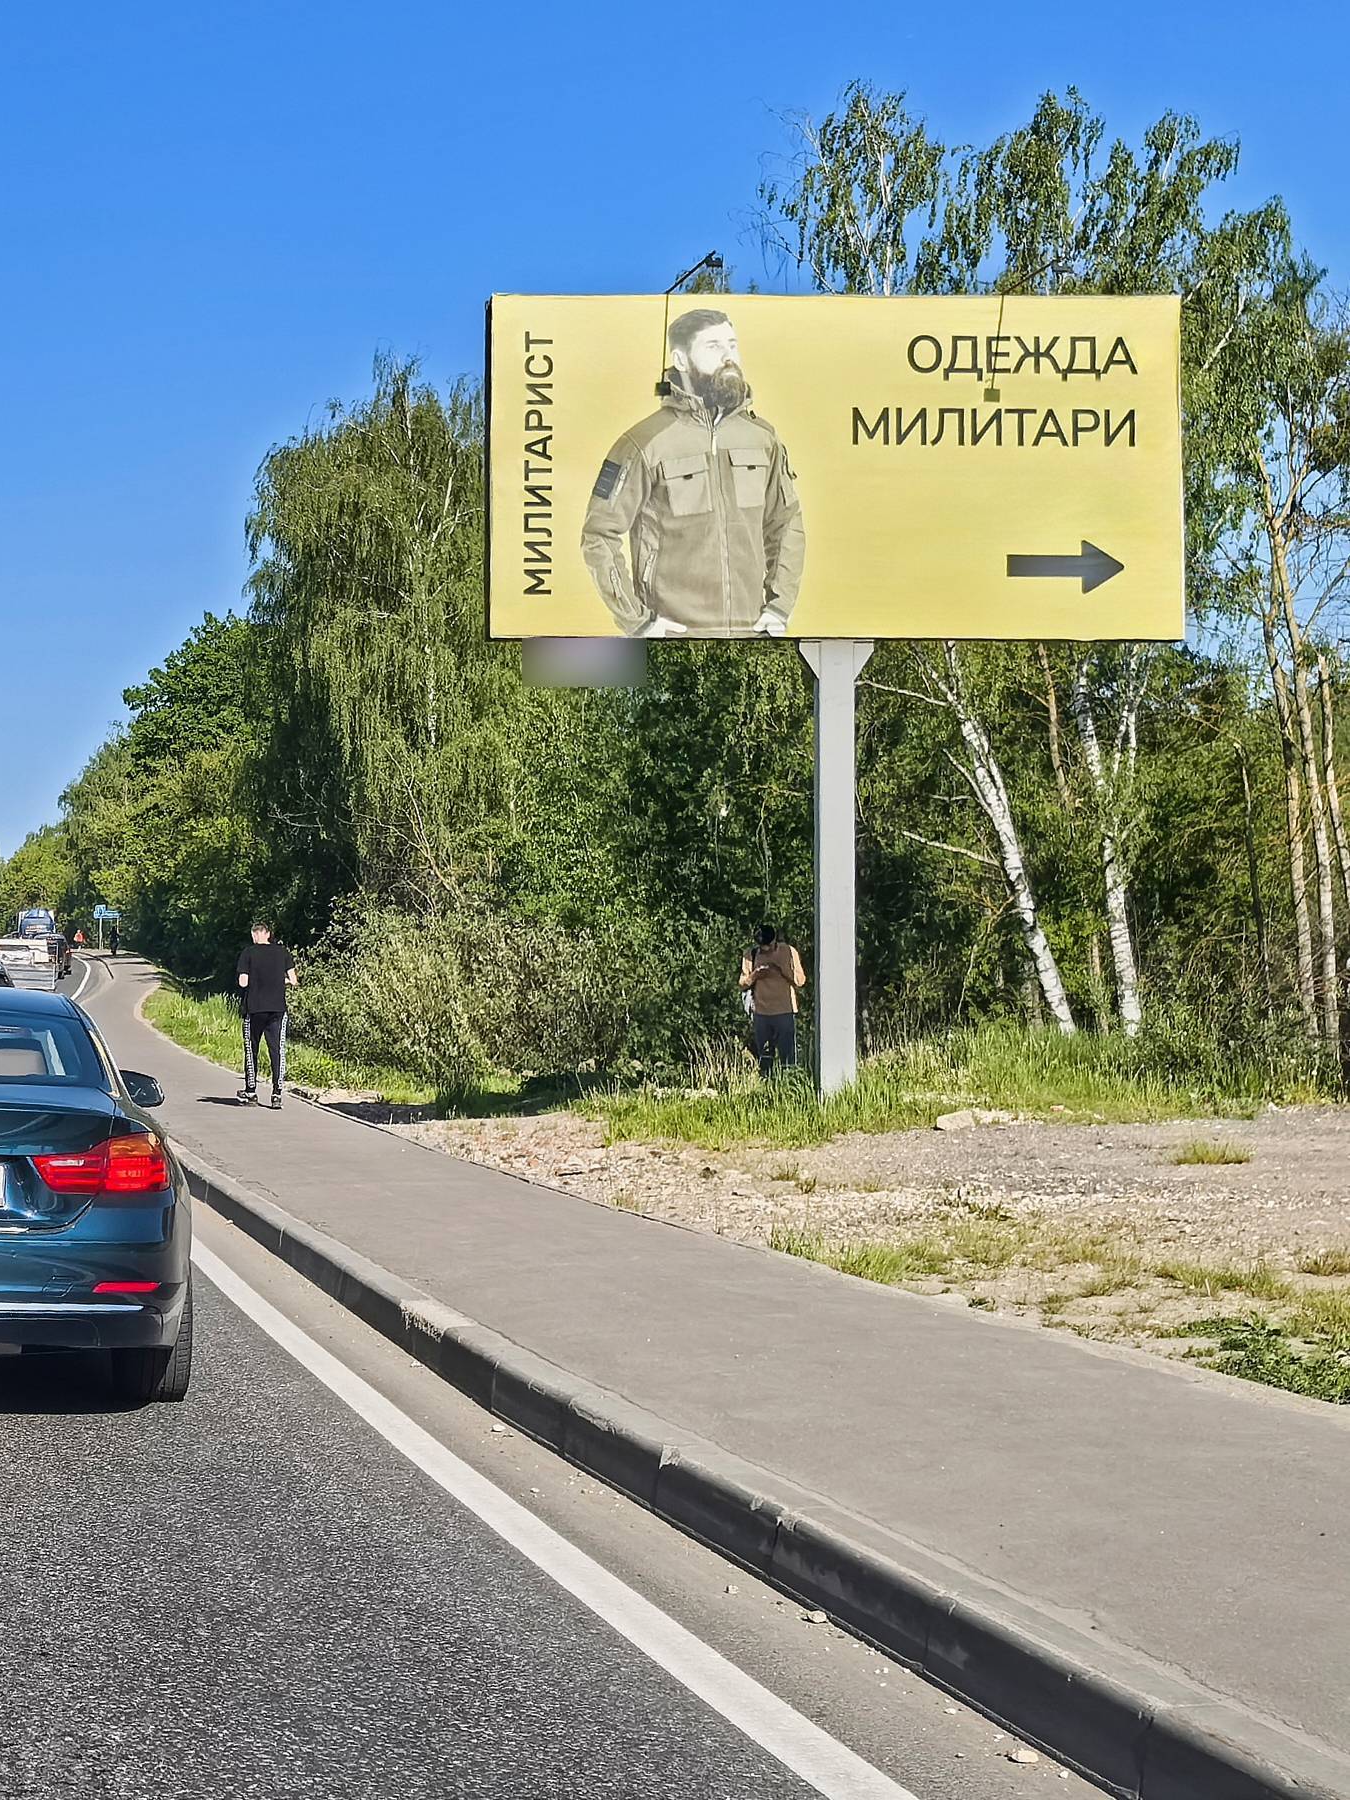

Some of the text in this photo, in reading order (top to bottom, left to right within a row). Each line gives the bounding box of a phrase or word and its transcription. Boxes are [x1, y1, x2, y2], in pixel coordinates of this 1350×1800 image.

[906, 334, 1138, 382] ОДЕЖДА
[851, 406, 1137, 448] МИЛИТАРИ
[523, 330, 554, 596] МИЛИТАРИСТ
